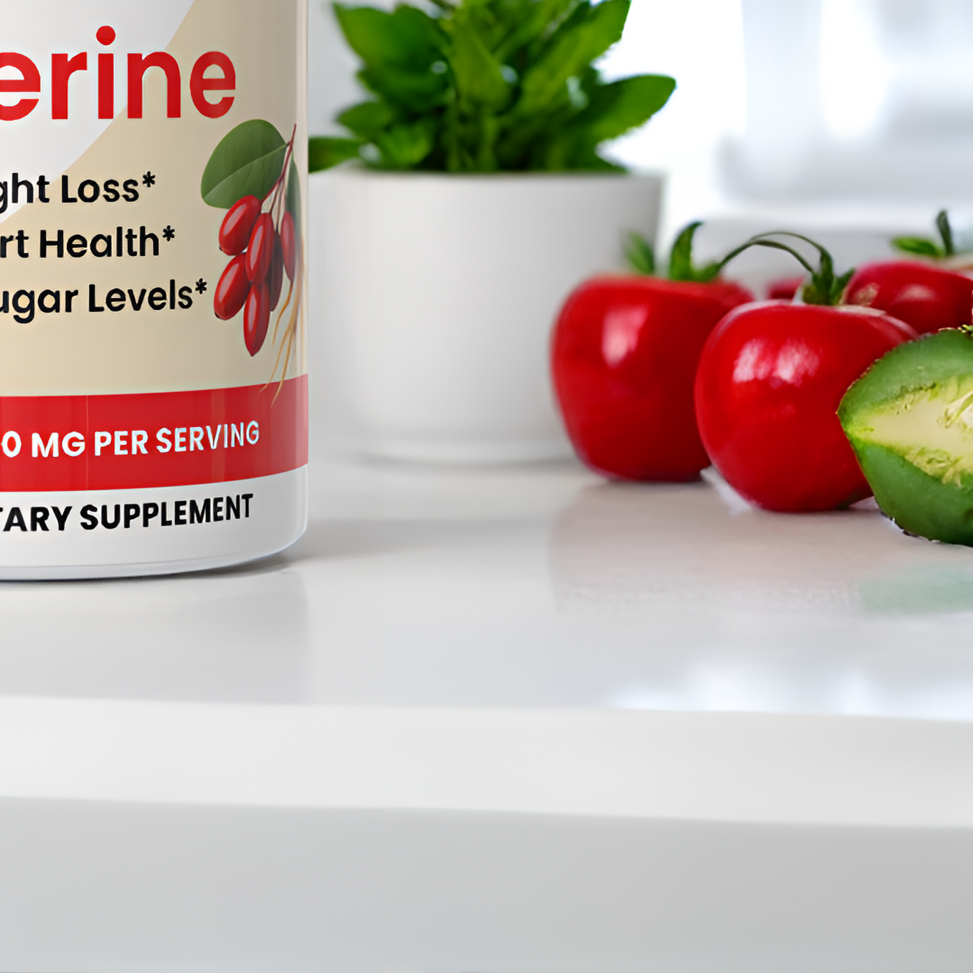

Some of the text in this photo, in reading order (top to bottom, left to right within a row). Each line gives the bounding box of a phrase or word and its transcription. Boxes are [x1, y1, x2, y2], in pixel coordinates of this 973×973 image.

[31, 432, 85, 459] MG
[94, 429, 148, 457] PER
[156, 421, 259, 455] SERVING
[81, 493, 253, 531] SUPPLEMENT
